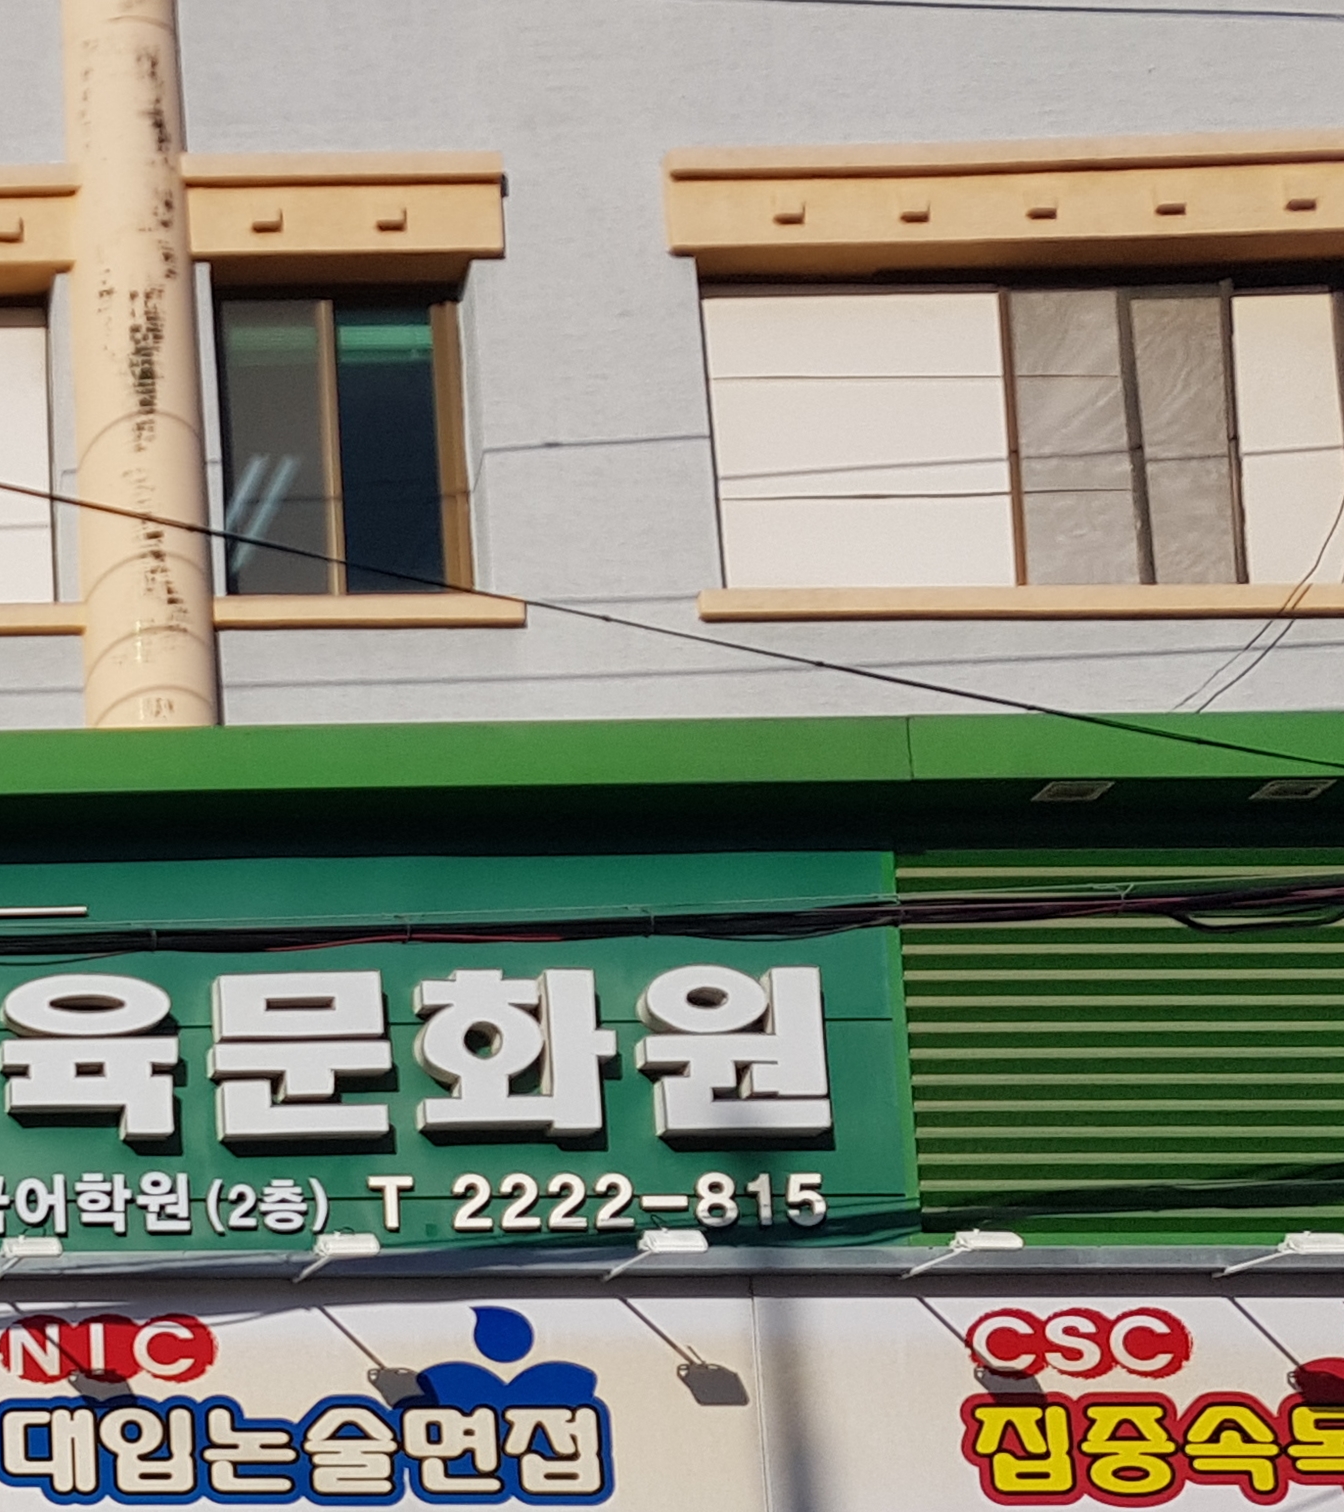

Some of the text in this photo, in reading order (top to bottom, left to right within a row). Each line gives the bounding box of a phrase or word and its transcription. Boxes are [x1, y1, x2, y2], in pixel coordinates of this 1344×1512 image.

[207, 1177, 329, 1232] (2층)
[367, 1176, 414, 1231] T
[452, 1172, 828, 1232] 2222-815
[7, 1320, 196, 1376] NIC
[973, 1314, 1175, 1373] CSC
[1, 1407, 606, 1497] 대입논술면접
